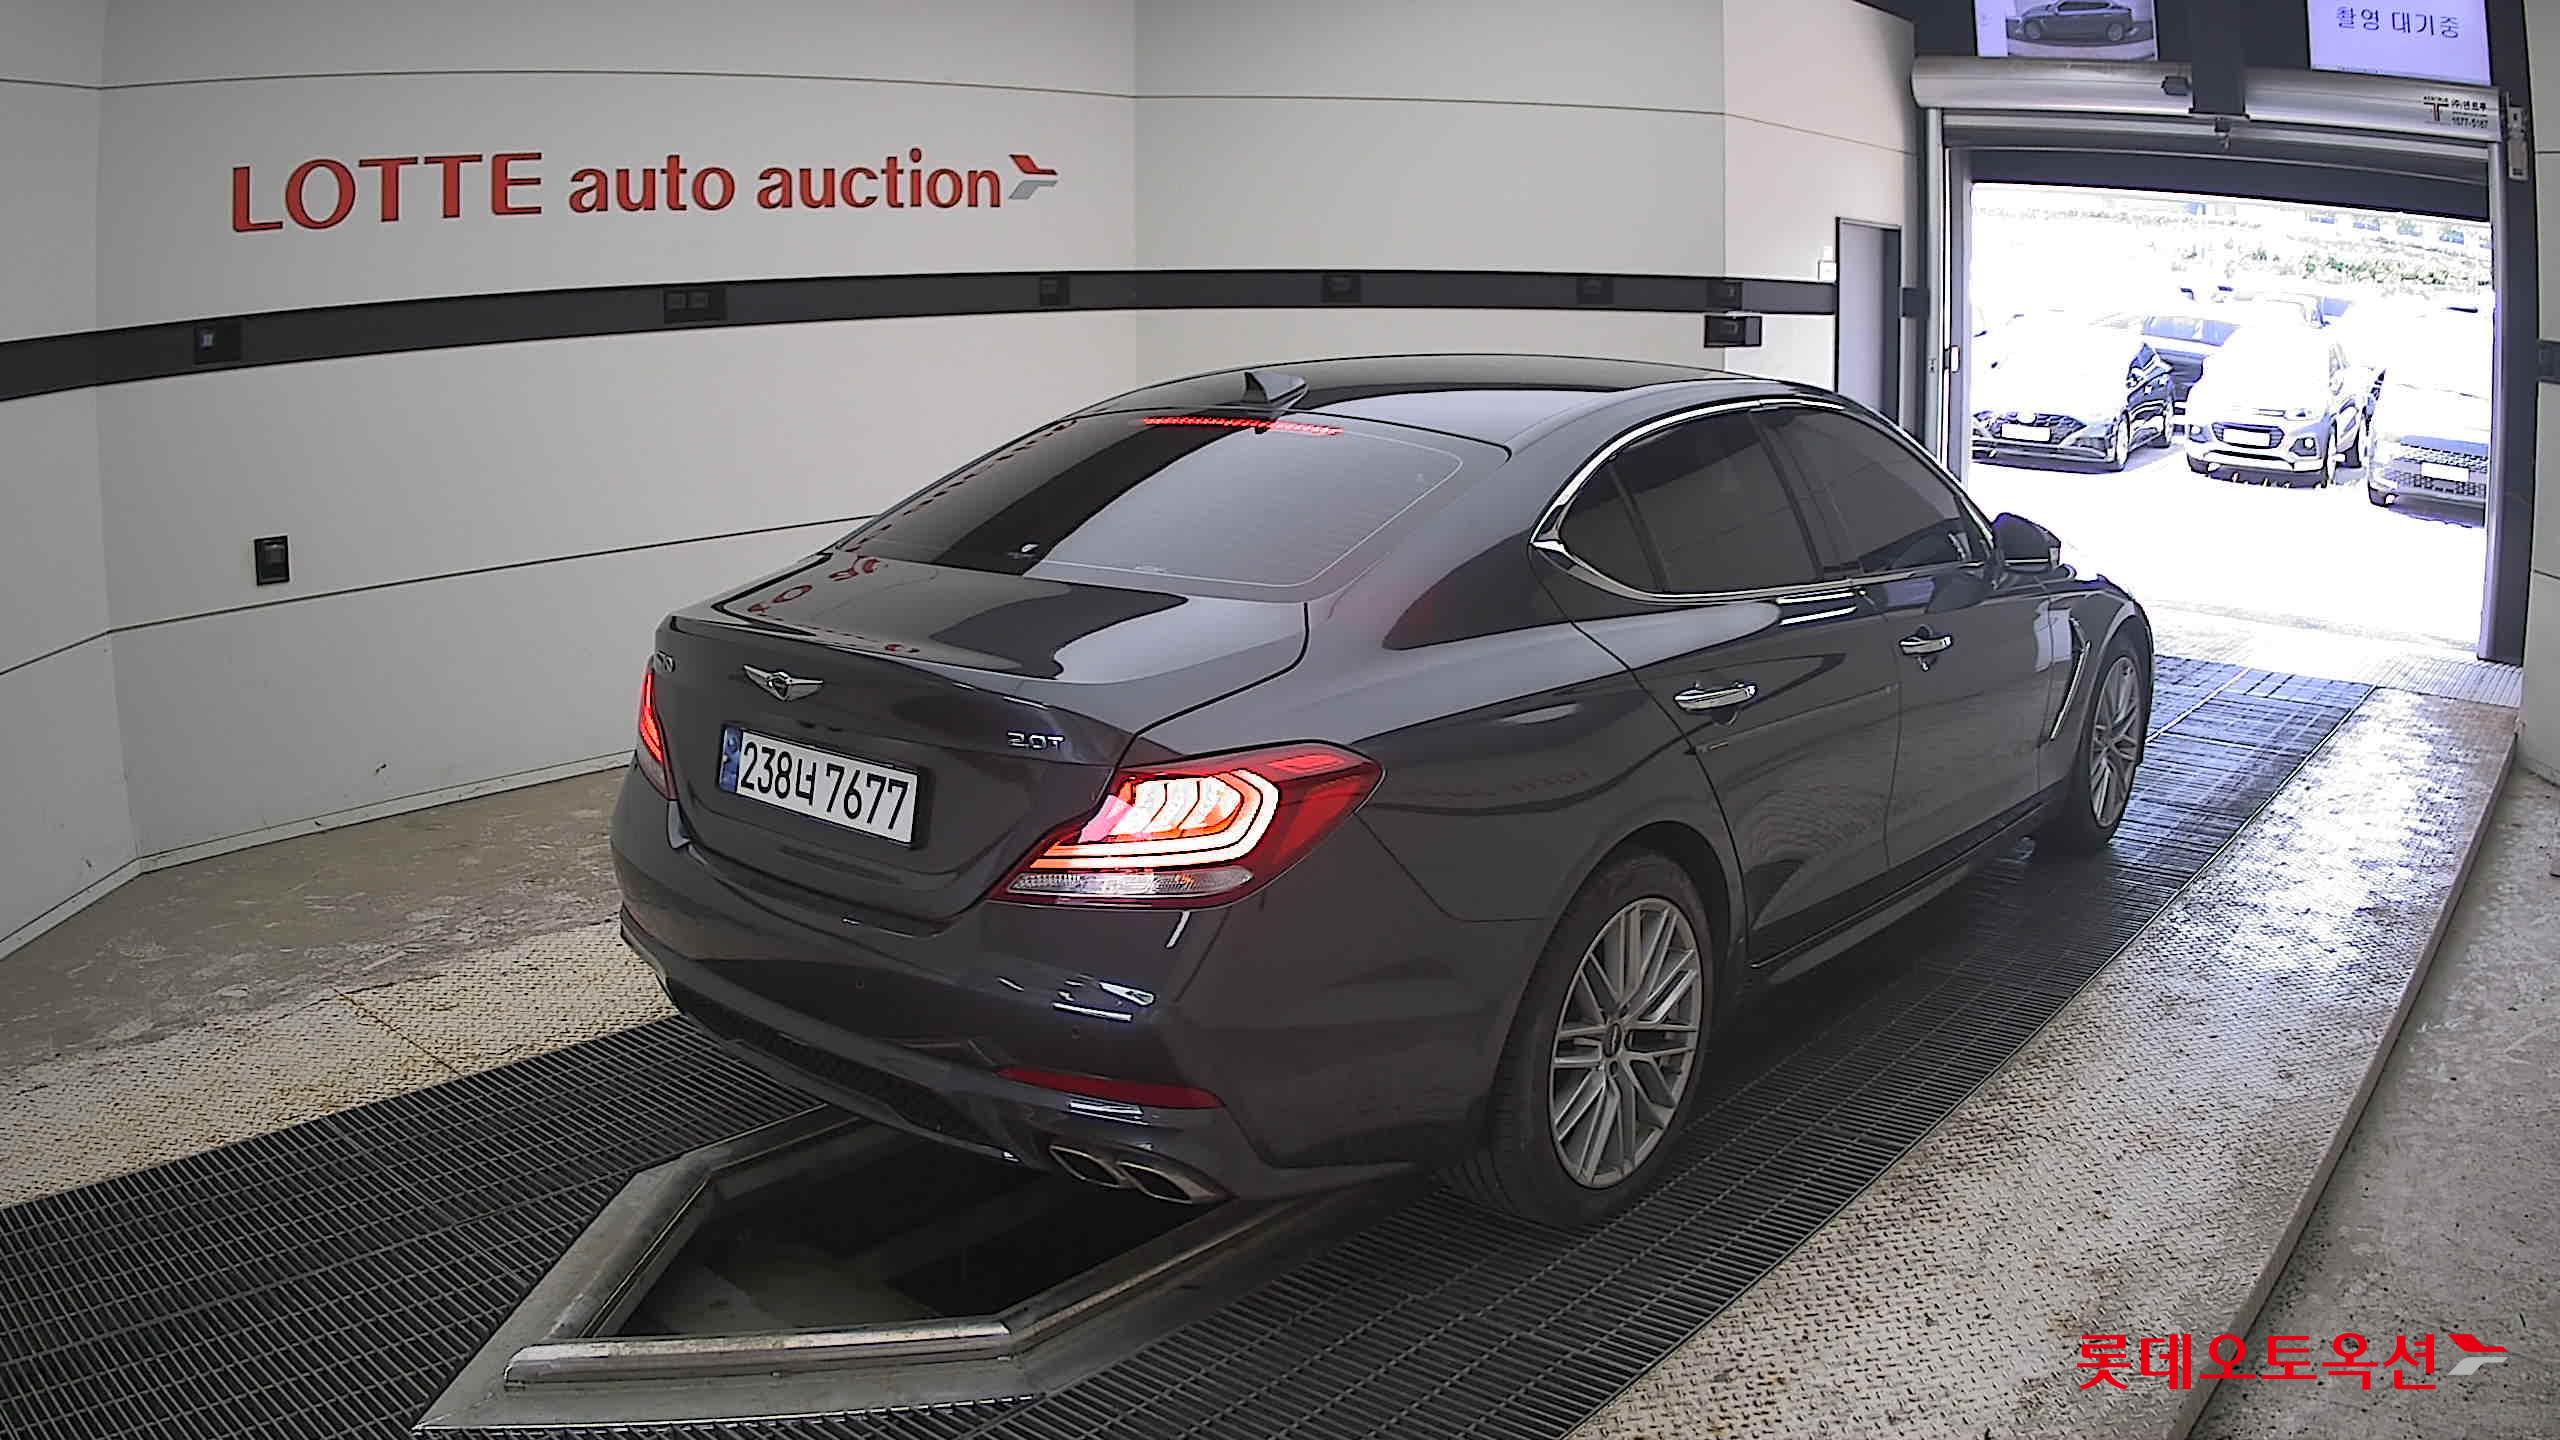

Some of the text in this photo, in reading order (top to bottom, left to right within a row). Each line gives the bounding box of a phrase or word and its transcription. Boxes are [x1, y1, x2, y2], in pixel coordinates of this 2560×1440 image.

[2337, 7, 2459, 38] 촬영 대기중
[231, 148, 1001, 232] LOTTE auto auction
[741, 741, 816, 806] 238너
[826, 762, 909, 829] 7677
